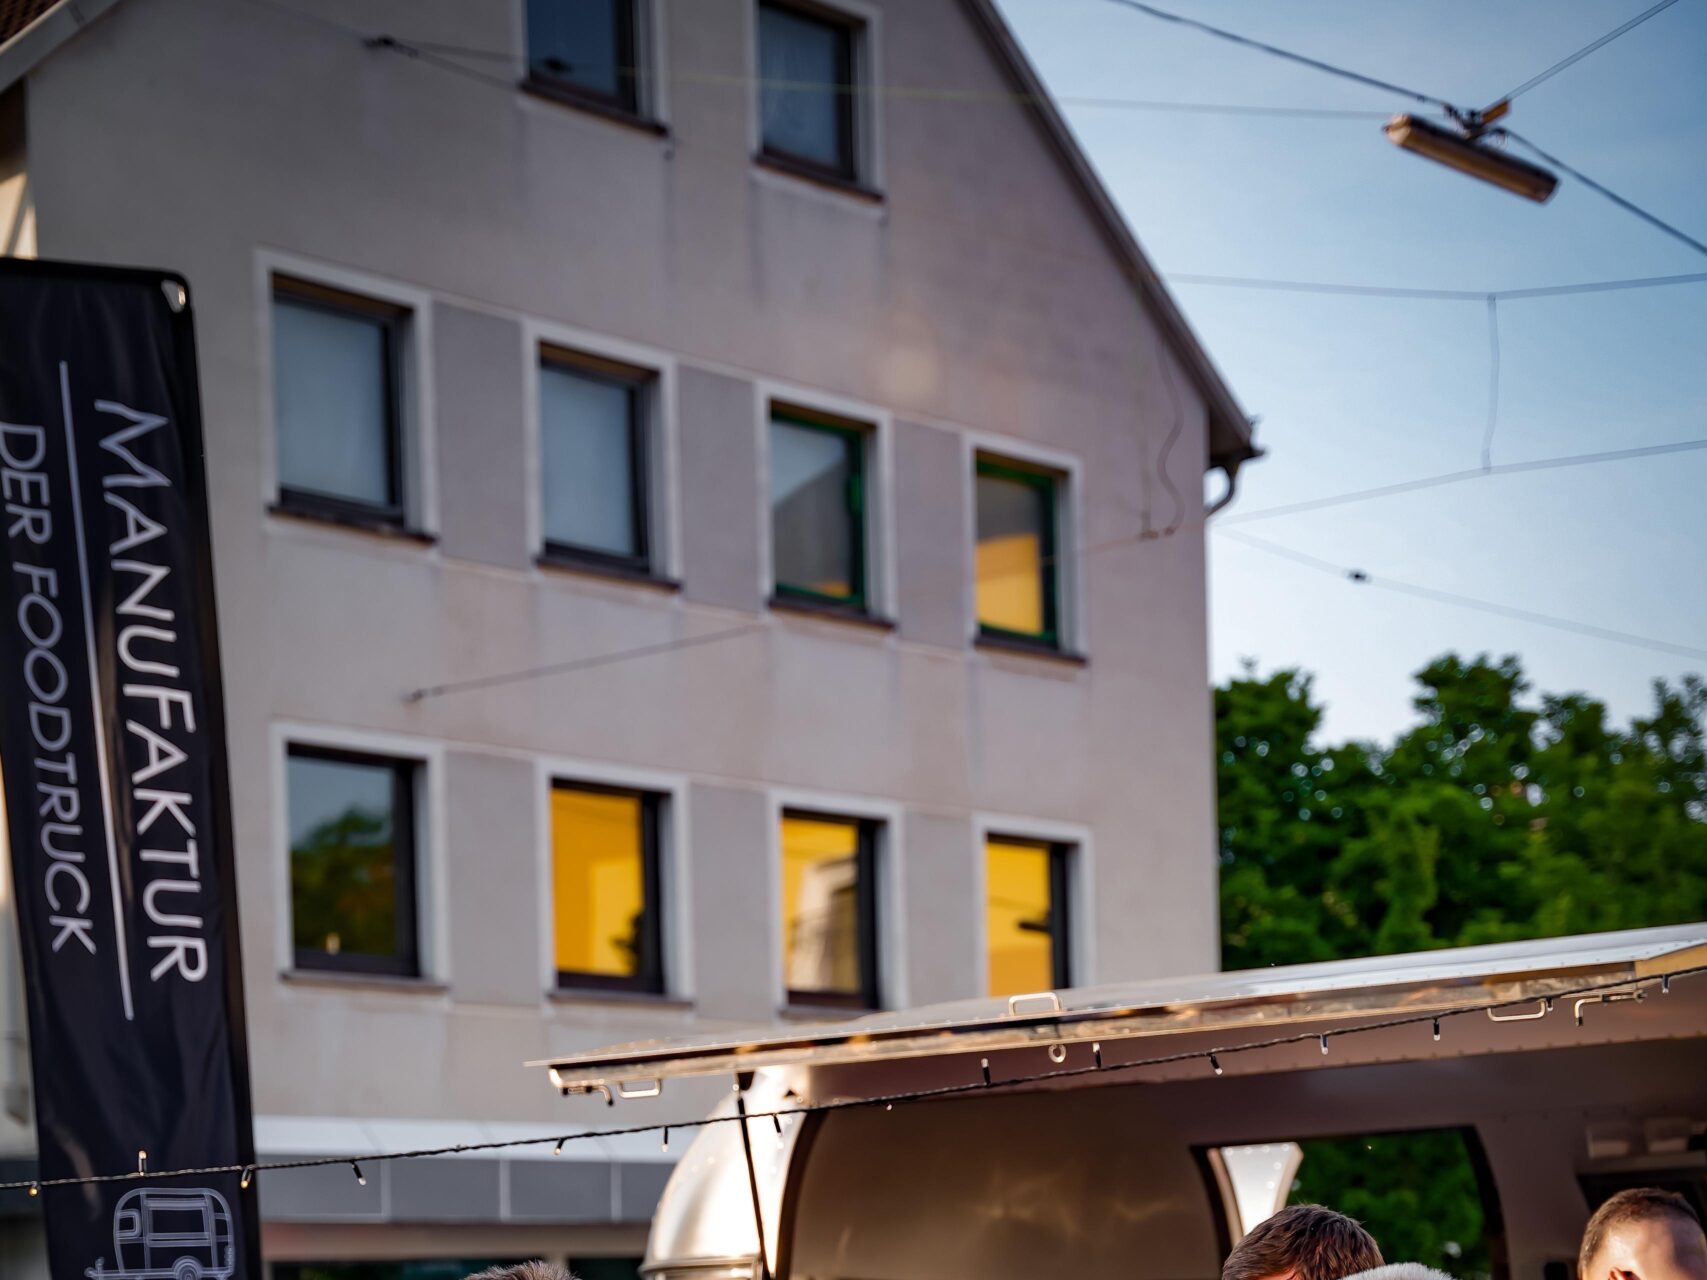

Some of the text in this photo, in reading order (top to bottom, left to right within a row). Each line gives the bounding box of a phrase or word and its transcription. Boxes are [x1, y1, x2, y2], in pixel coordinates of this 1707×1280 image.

[0, 421, 97, 955] DER FOODTRUCK
[94, 399, 208, 983] MANUFAKTUR
